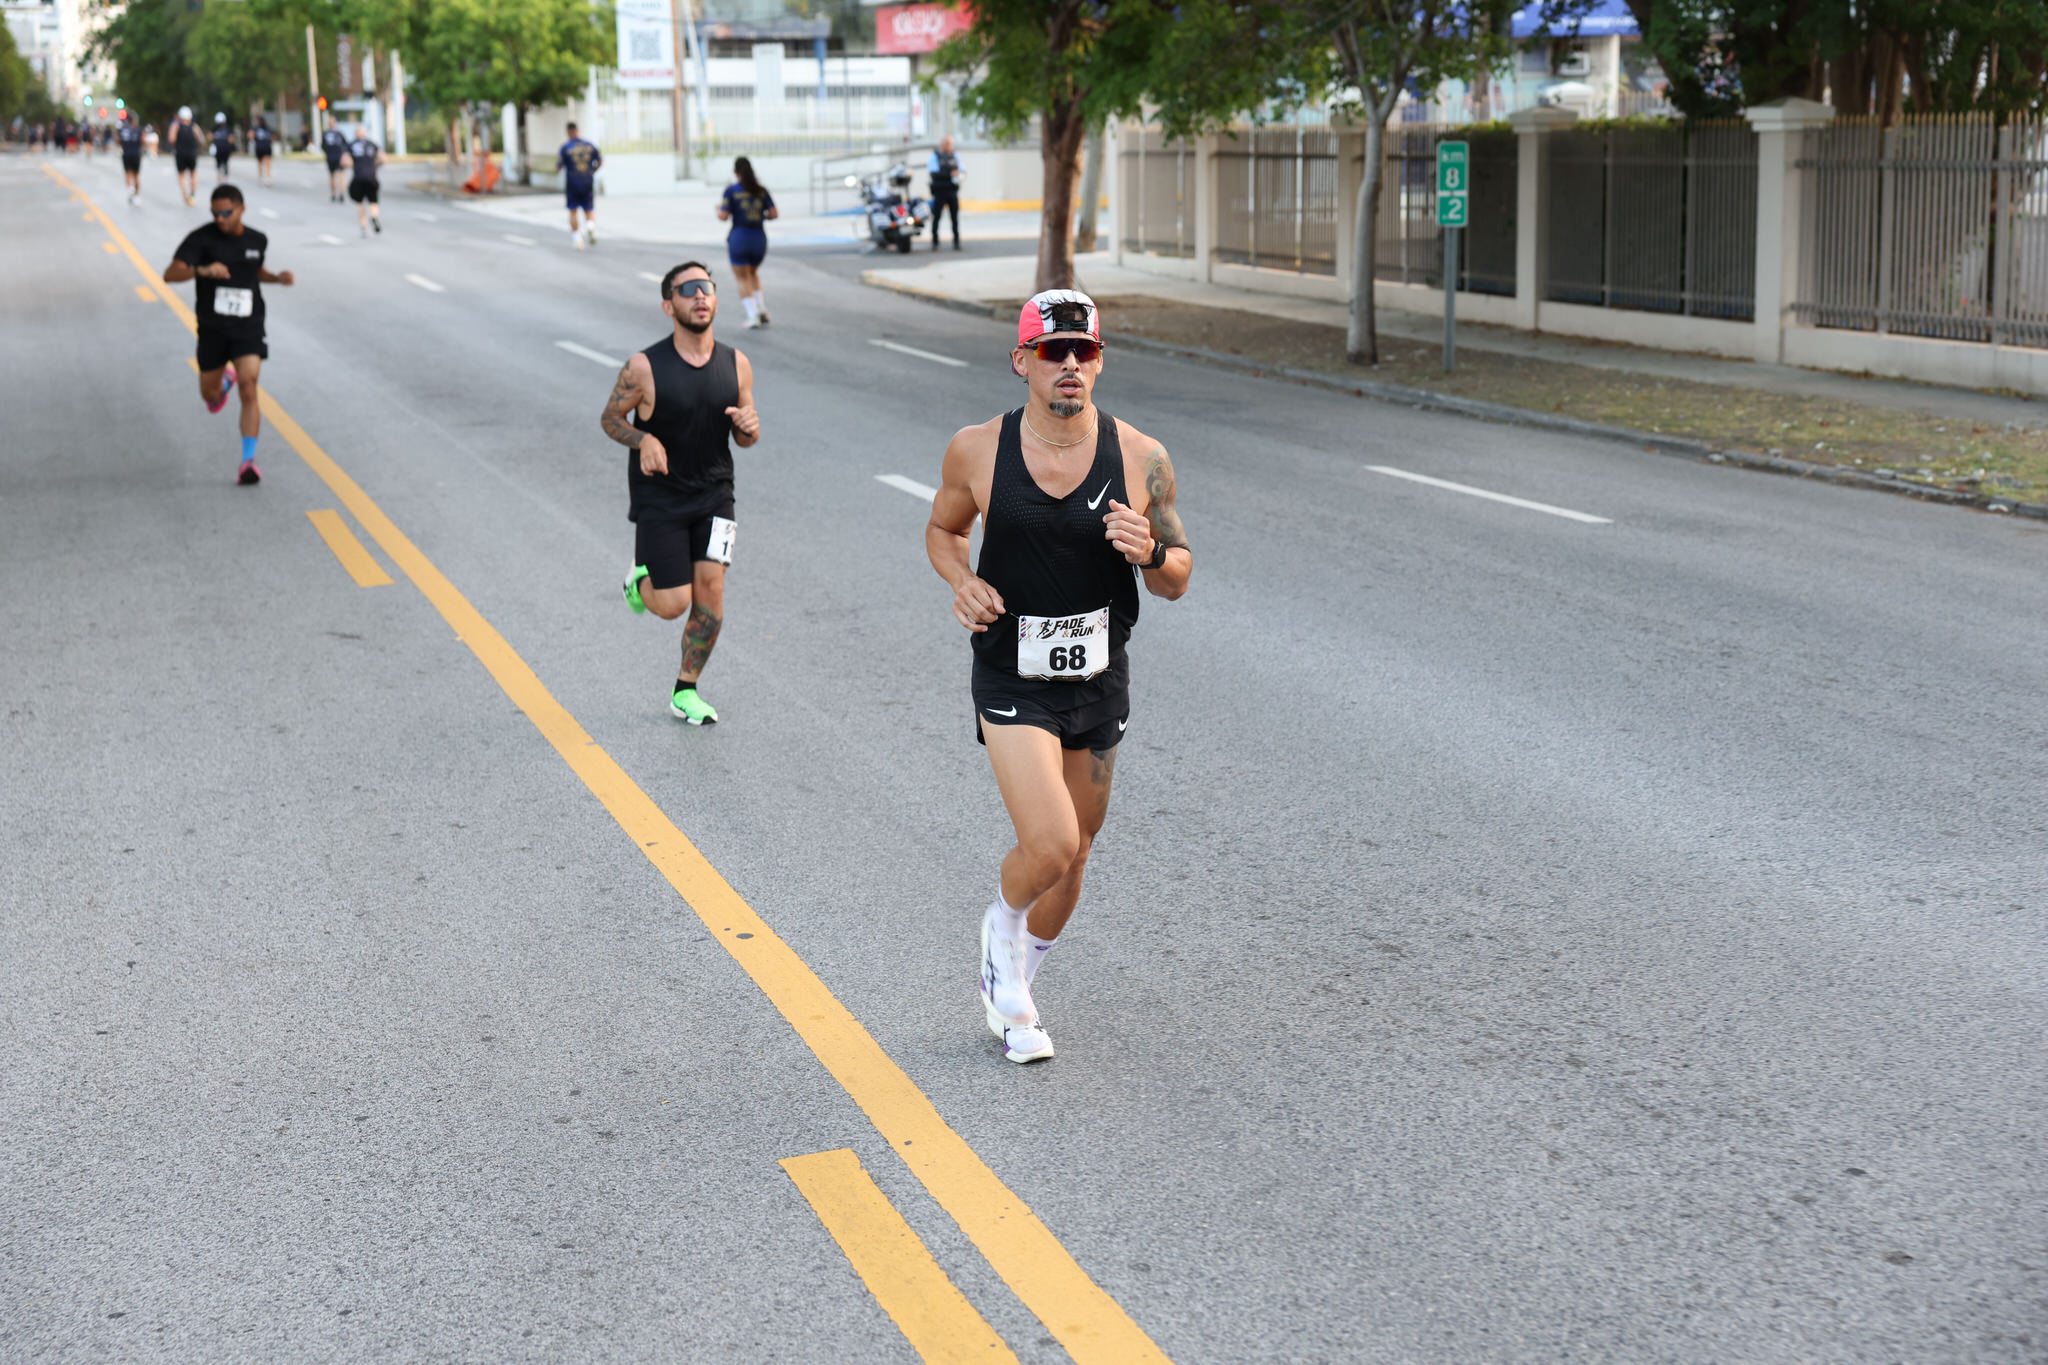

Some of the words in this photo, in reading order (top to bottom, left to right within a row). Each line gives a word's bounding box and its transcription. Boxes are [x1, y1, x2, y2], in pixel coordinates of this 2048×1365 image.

[1445, 167, 1460, 188] 8
[1053, 617, 1086, 631] FADE
[1062, 630, 1069, 638] &
[1070, 625, 1095, 638] RUN
[1049, 645, 1087, 671] 68
